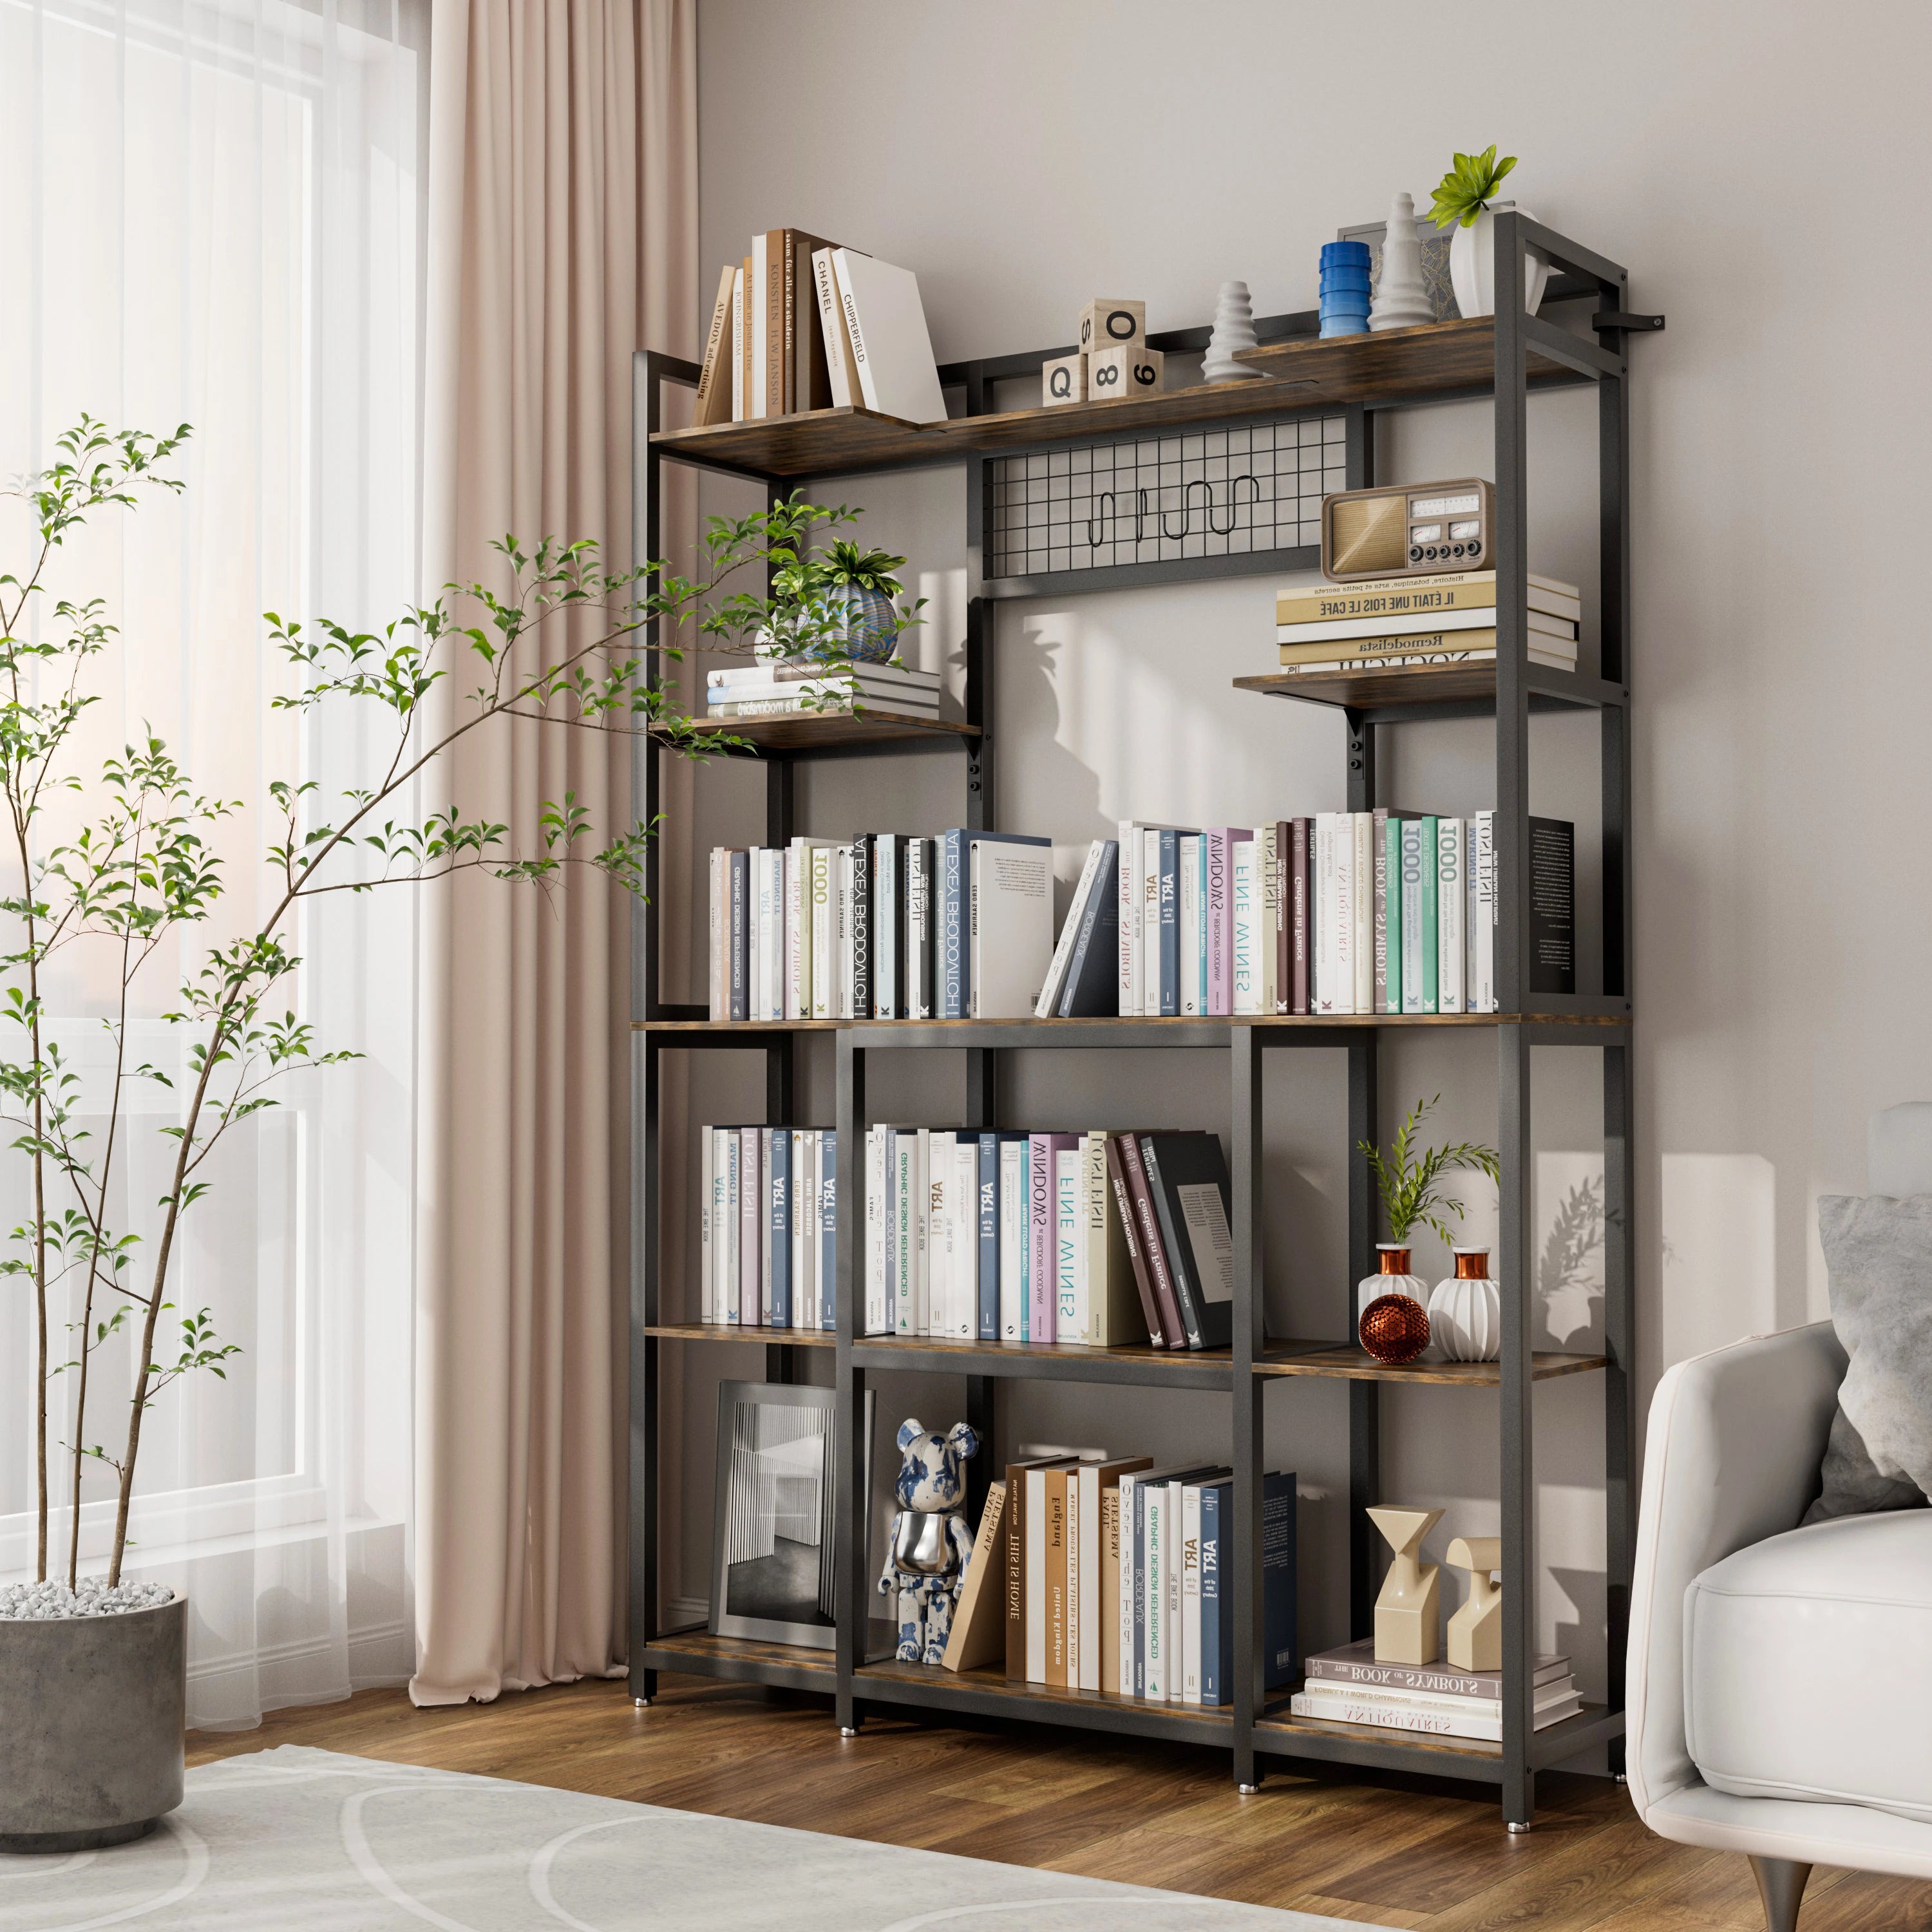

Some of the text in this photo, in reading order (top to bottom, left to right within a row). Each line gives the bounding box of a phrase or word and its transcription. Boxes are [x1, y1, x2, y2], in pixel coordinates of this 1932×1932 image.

[818, 261, 831, 314] CHANEL
[844, 294, 865, 363] CHIPPERFIELD
[1082, 318, 1091, 345] S
[1106, 311, 1136, 339] O
[698, 301, 724, 399] AVEDON advertising
[1050, 366, 1071, 398] Q
[1097, 365, 1118, 386] 8
